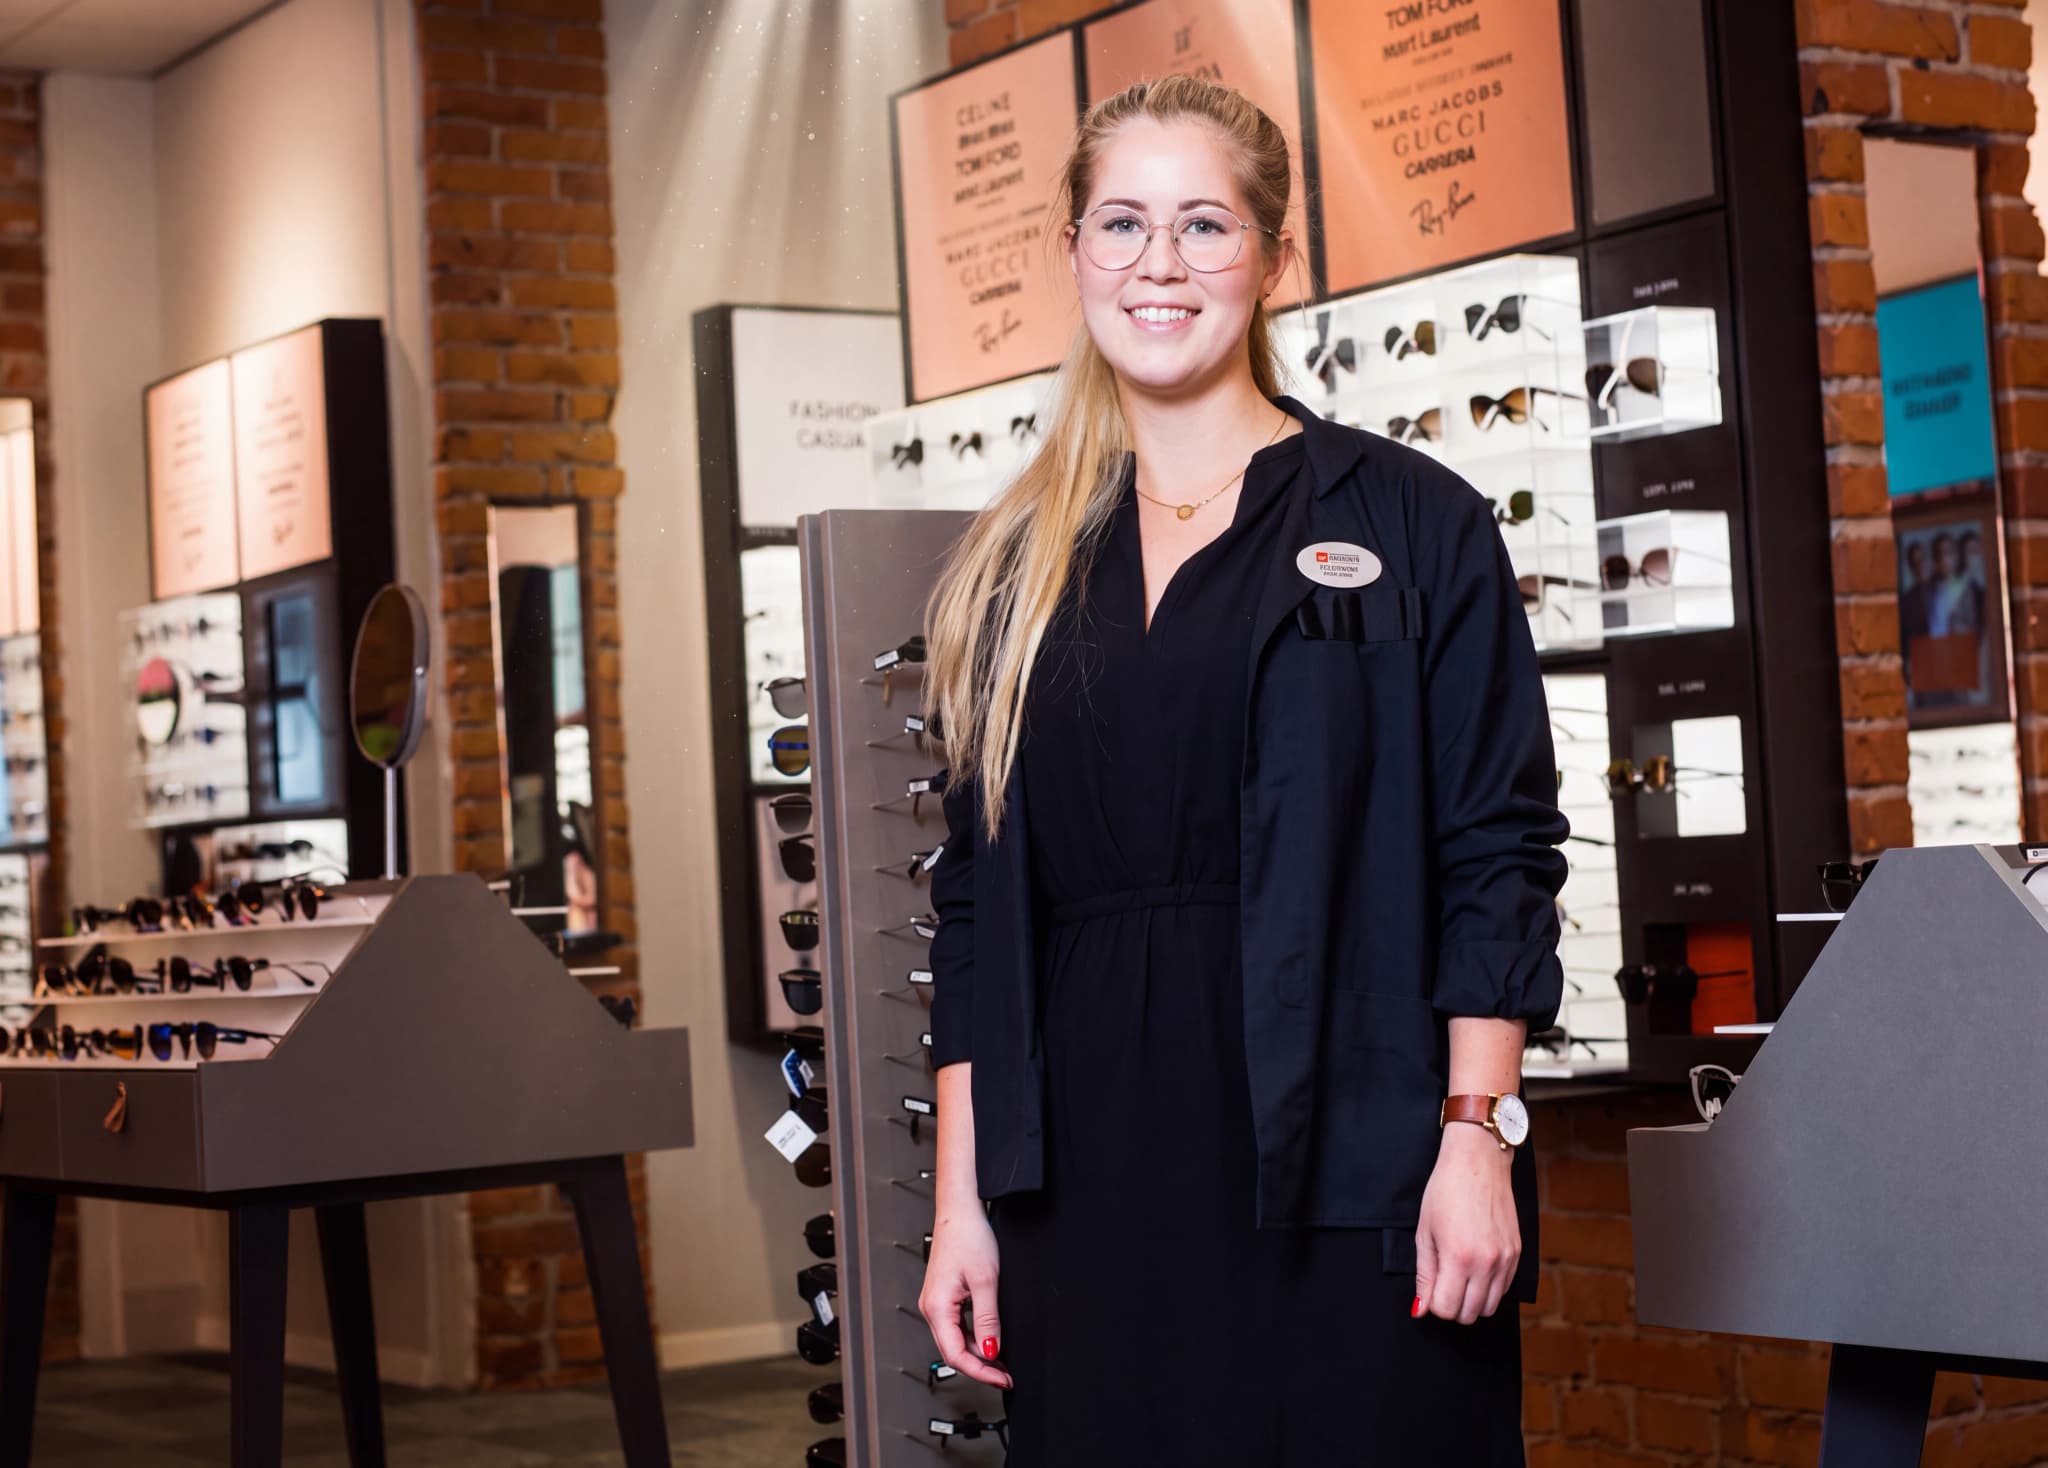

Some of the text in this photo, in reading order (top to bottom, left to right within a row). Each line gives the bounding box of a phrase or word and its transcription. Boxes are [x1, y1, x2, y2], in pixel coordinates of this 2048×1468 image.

[1385, 1, 1424, 30] TOM
[1372, 105, 1421, 131] MARC
[1429, 80, 1503, 115] JACOBS
[1393, 111, 1486, 157] GUCCI
[1404, 146, 1475, 179] CARRERA
[797, 427, 865, 449] CASUA
